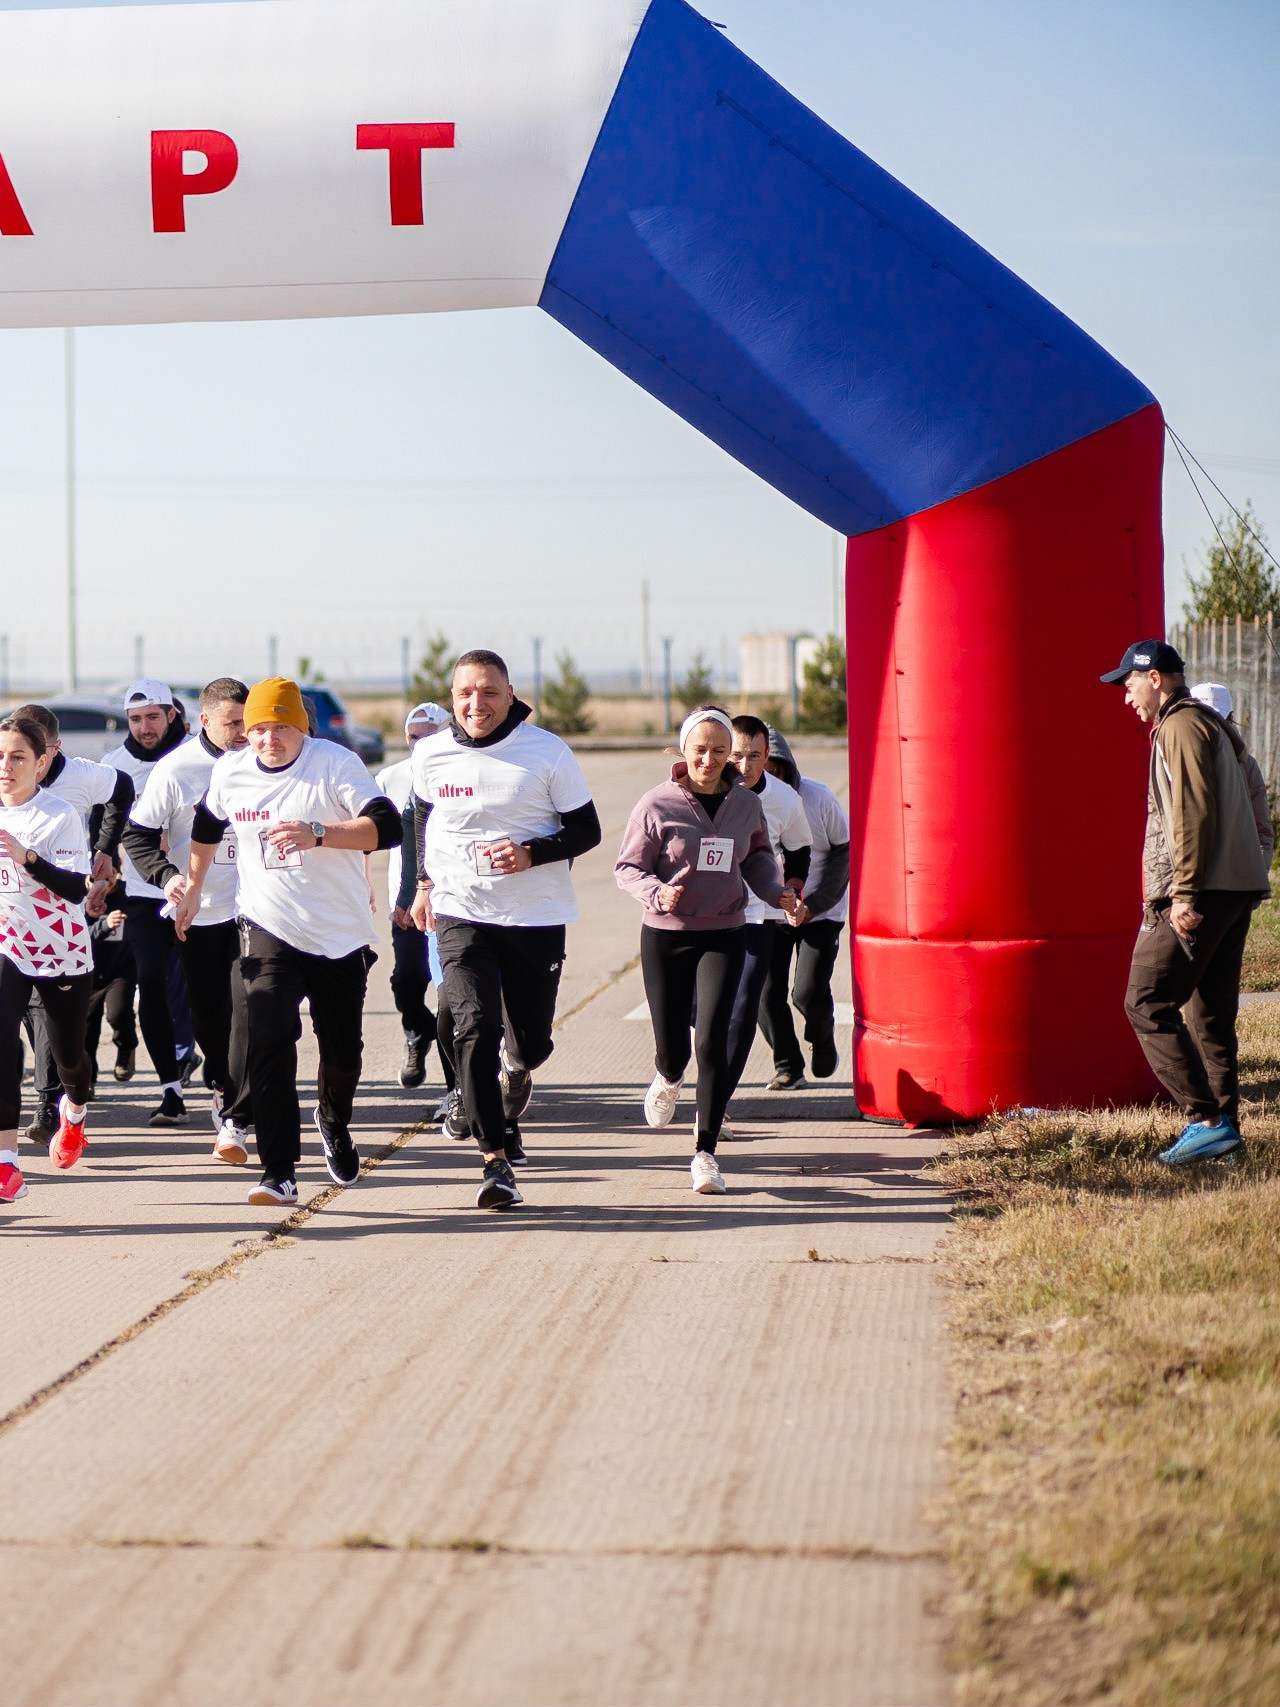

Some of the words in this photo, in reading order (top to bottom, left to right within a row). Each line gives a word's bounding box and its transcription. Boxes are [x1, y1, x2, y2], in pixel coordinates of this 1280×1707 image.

[438, 783, 474, 798] ultra
[234, 807, 270, 822] ultra
[706, 850, 724, 866] 67
